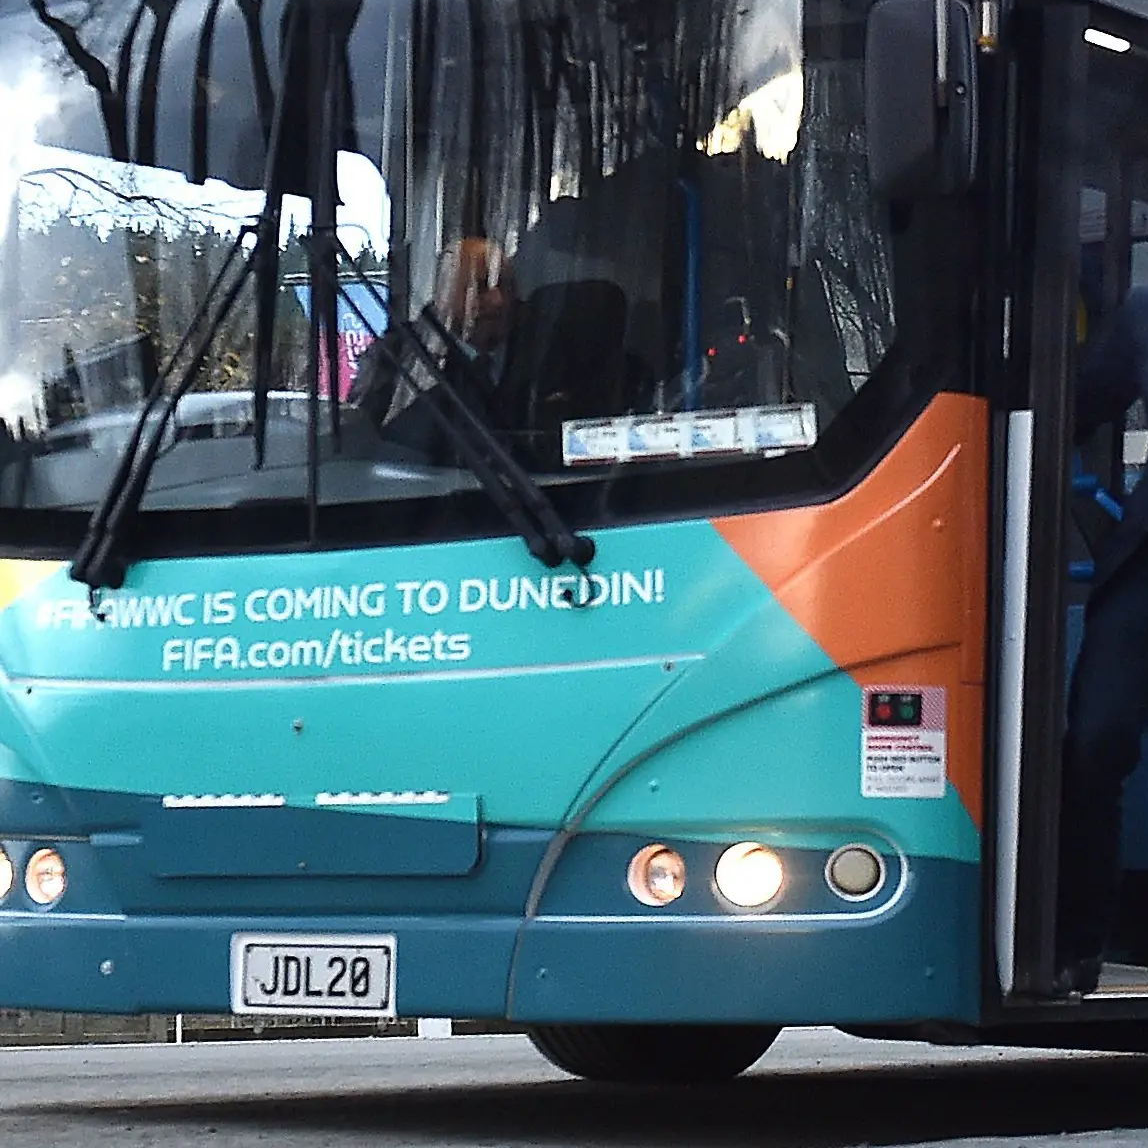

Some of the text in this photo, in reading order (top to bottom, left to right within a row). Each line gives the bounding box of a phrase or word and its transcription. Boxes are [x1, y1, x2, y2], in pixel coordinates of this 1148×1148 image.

[203, 590, 231, 625] IS
[244, 580, 386, 622] COMING
[396, 578, 449, 615] TO
[459, 567, 665, 612] DUNEDIN!
[162, 628, 471, 671] FIFA.com/tickets
[259, 955, 370, 997] JDL20
